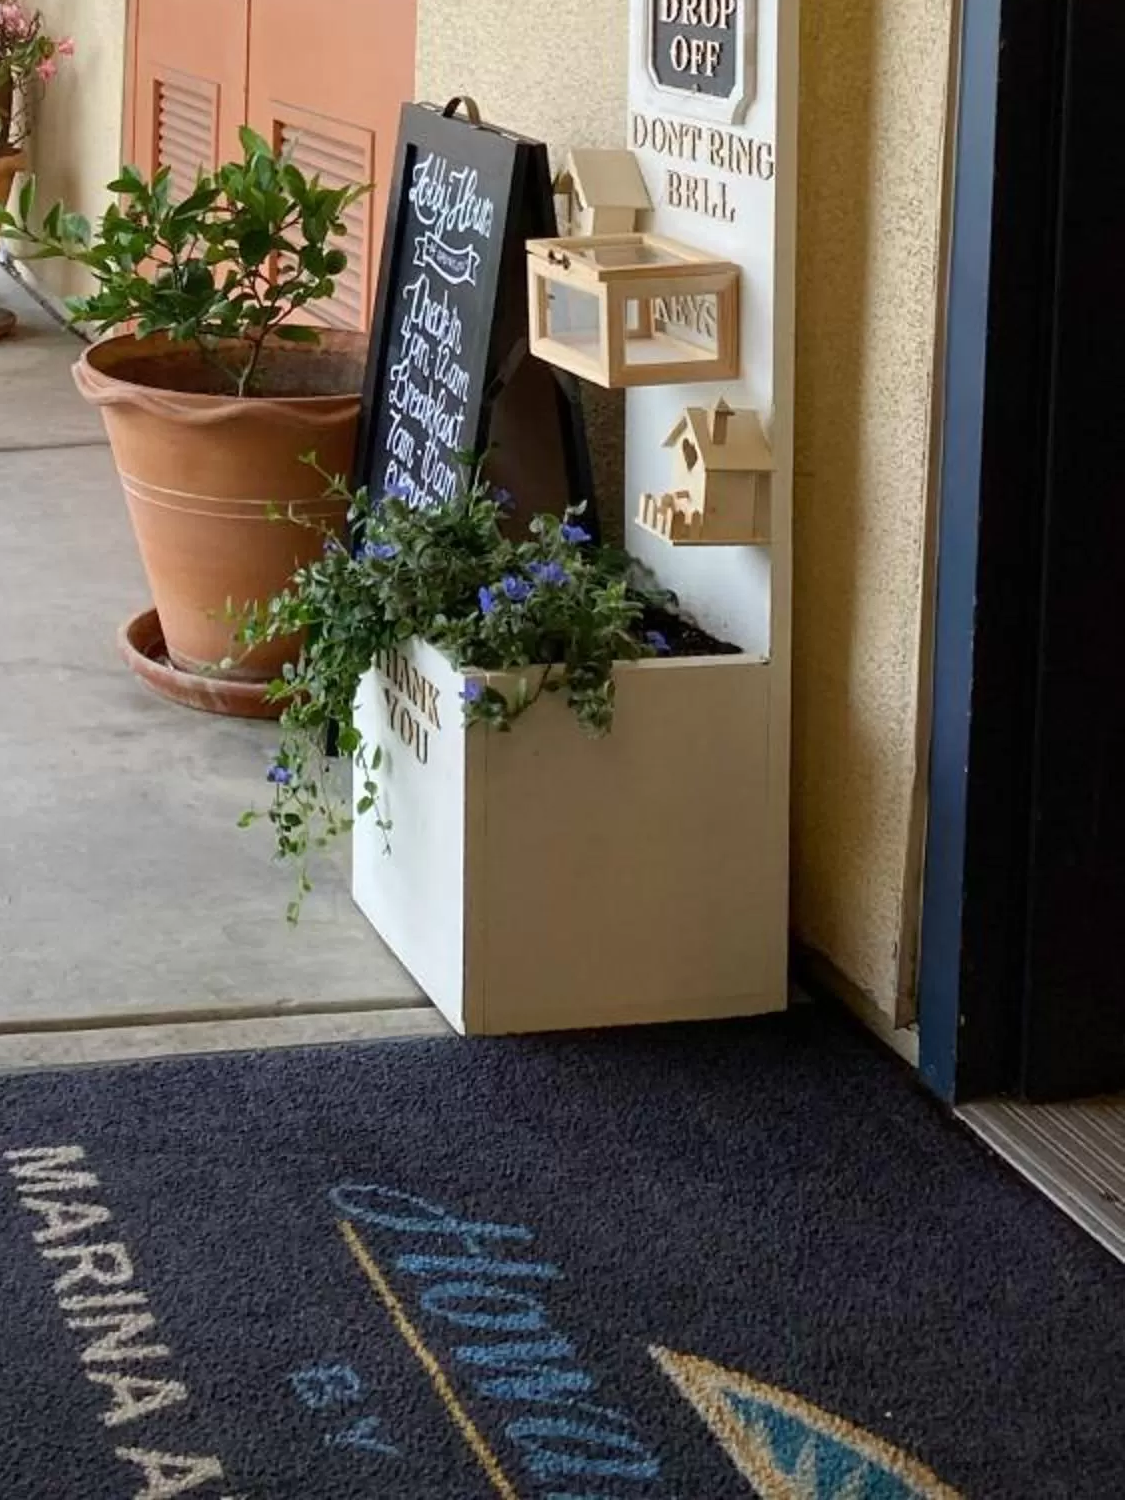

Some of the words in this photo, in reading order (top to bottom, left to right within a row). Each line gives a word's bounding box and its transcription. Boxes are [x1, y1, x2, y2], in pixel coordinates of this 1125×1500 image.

[670, 35, 721, 77] OFF
[707, 127, 775, 181] RING
[666, 168, 736, 223] BELL
[383, 687, 429, 765] YOU
[2, 1144, 190, 1428] MARINA
[115, 1446, 233, 1500] A
